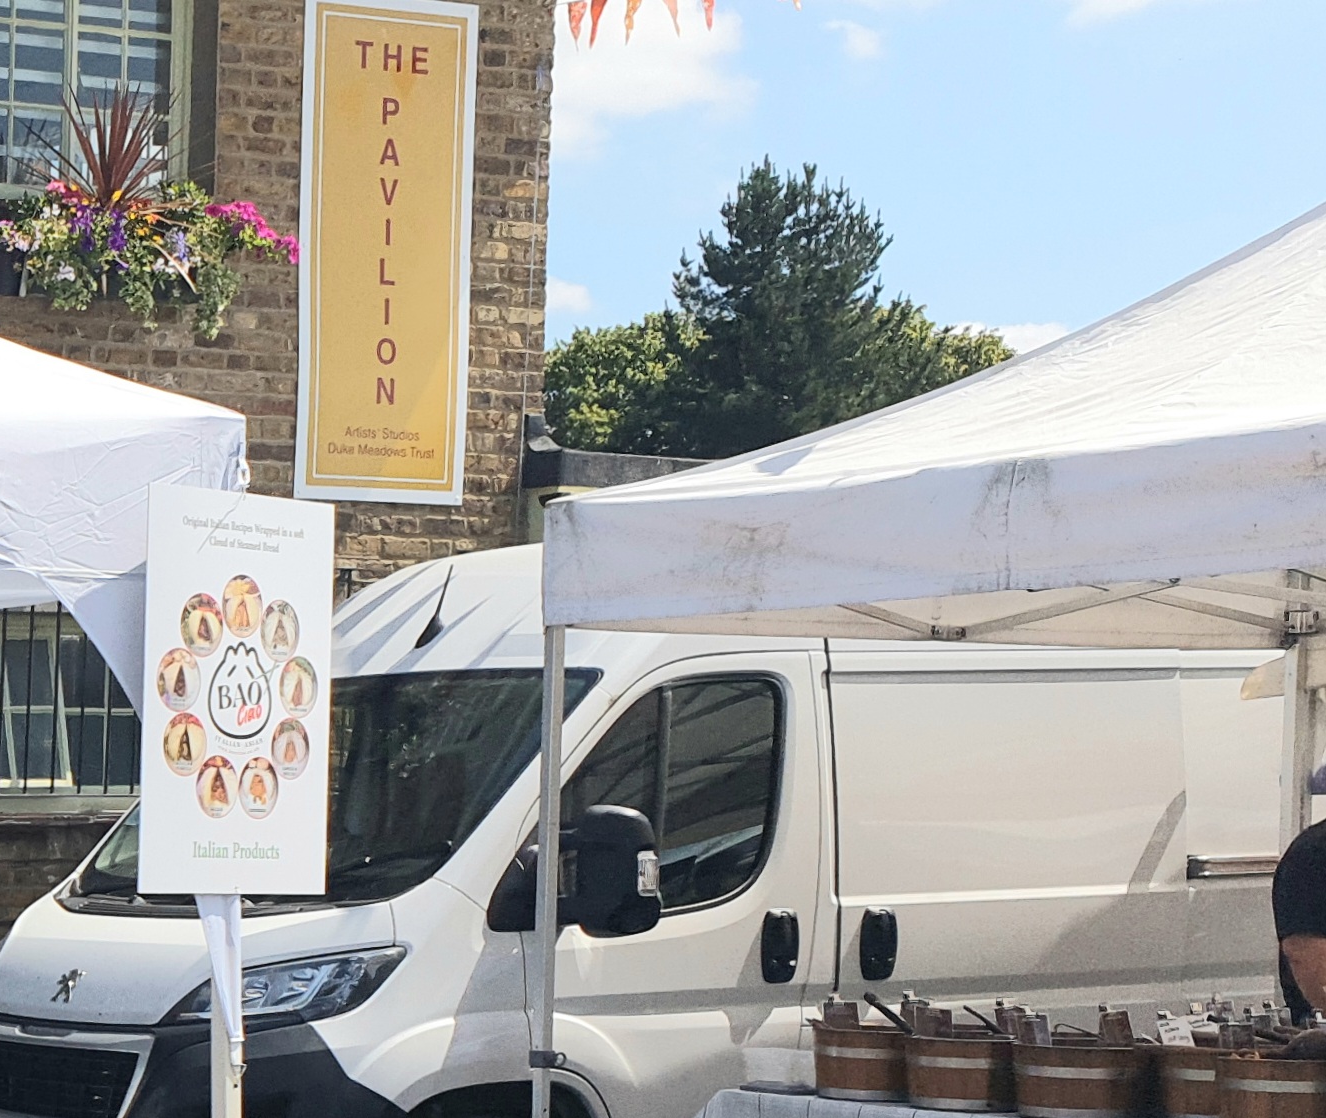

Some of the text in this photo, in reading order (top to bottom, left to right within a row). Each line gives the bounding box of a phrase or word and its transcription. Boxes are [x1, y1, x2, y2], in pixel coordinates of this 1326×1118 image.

[355, 40, 429, 75] THE
[376, 97, 400, 405] PAVILION
[382, 428, 420, 441] Studios
[357, 443, 407, 457] Meadows
[411, 447, 435, 459] Trust
[218, 681, 262, 709] BAO
[192, 841, 280, 860] Italian Products
